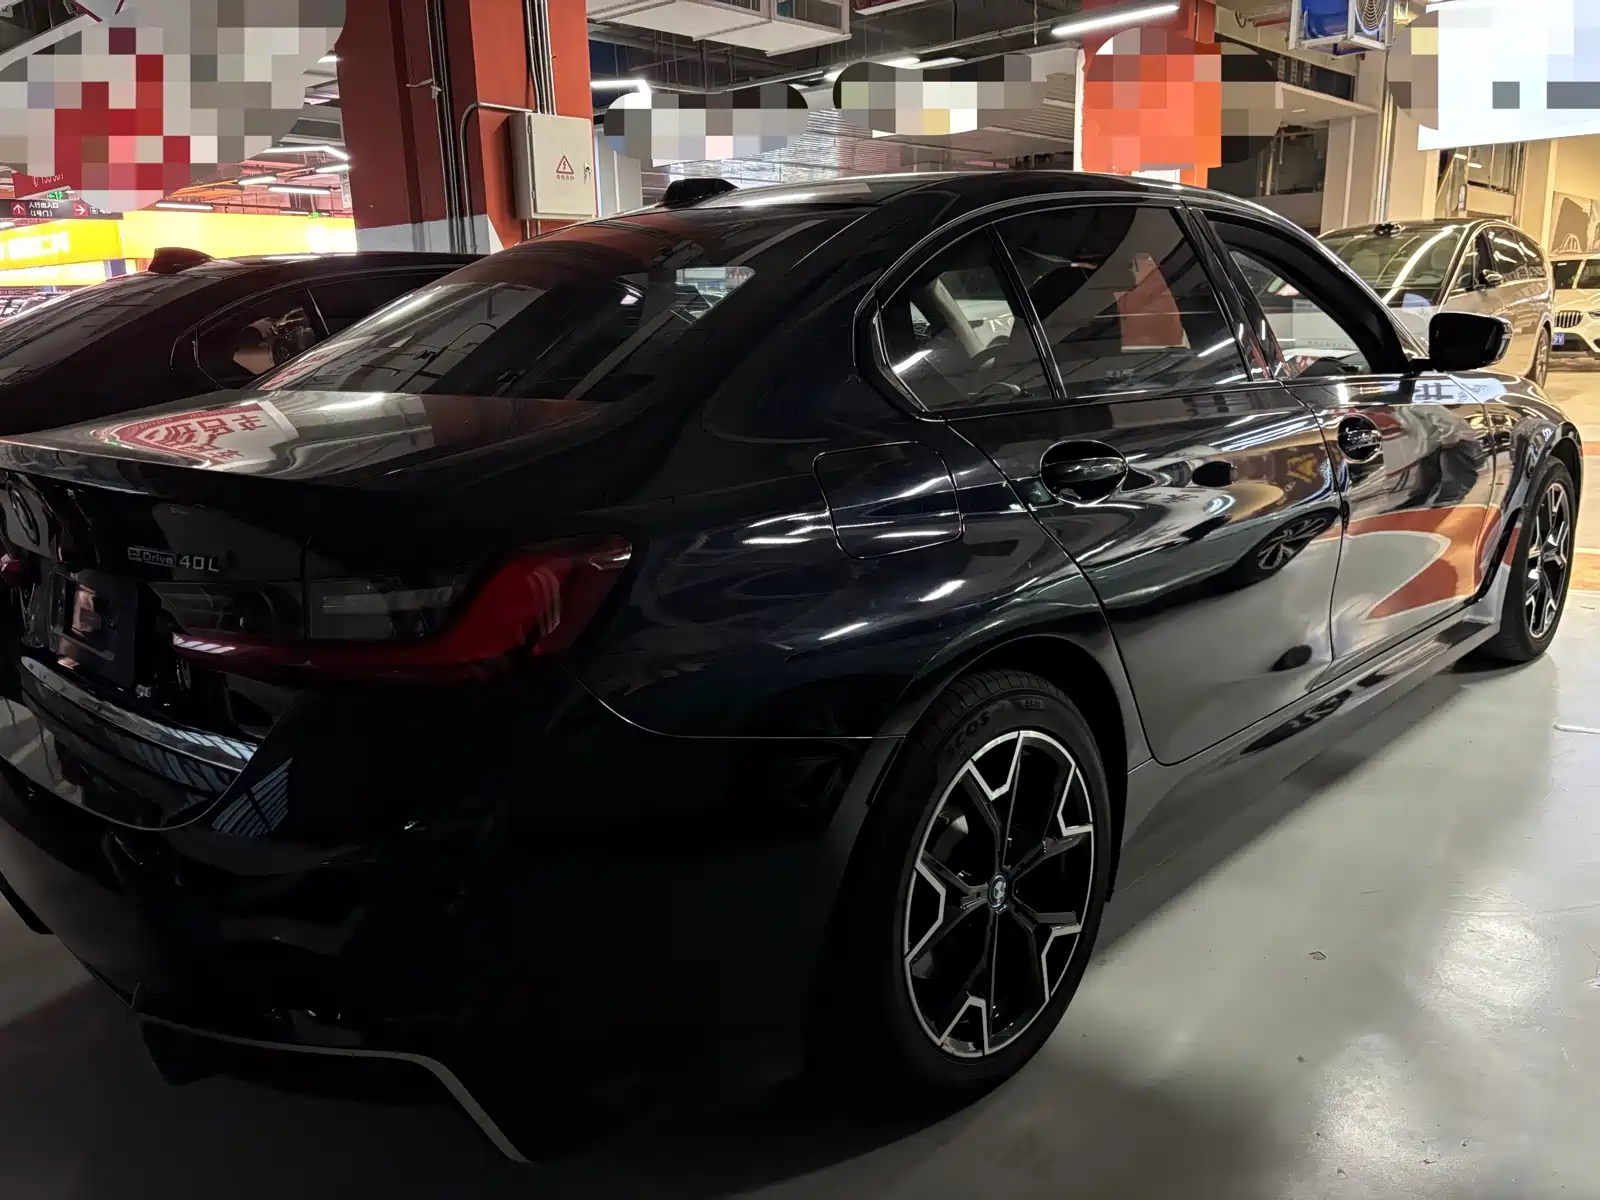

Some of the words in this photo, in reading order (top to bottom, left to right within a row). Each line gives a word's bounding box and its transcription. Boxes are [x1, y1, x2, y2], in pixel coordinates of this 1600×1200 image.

[28, 201, 59, 209] 人行出入口
[180, 555, 219, 572] 40L
